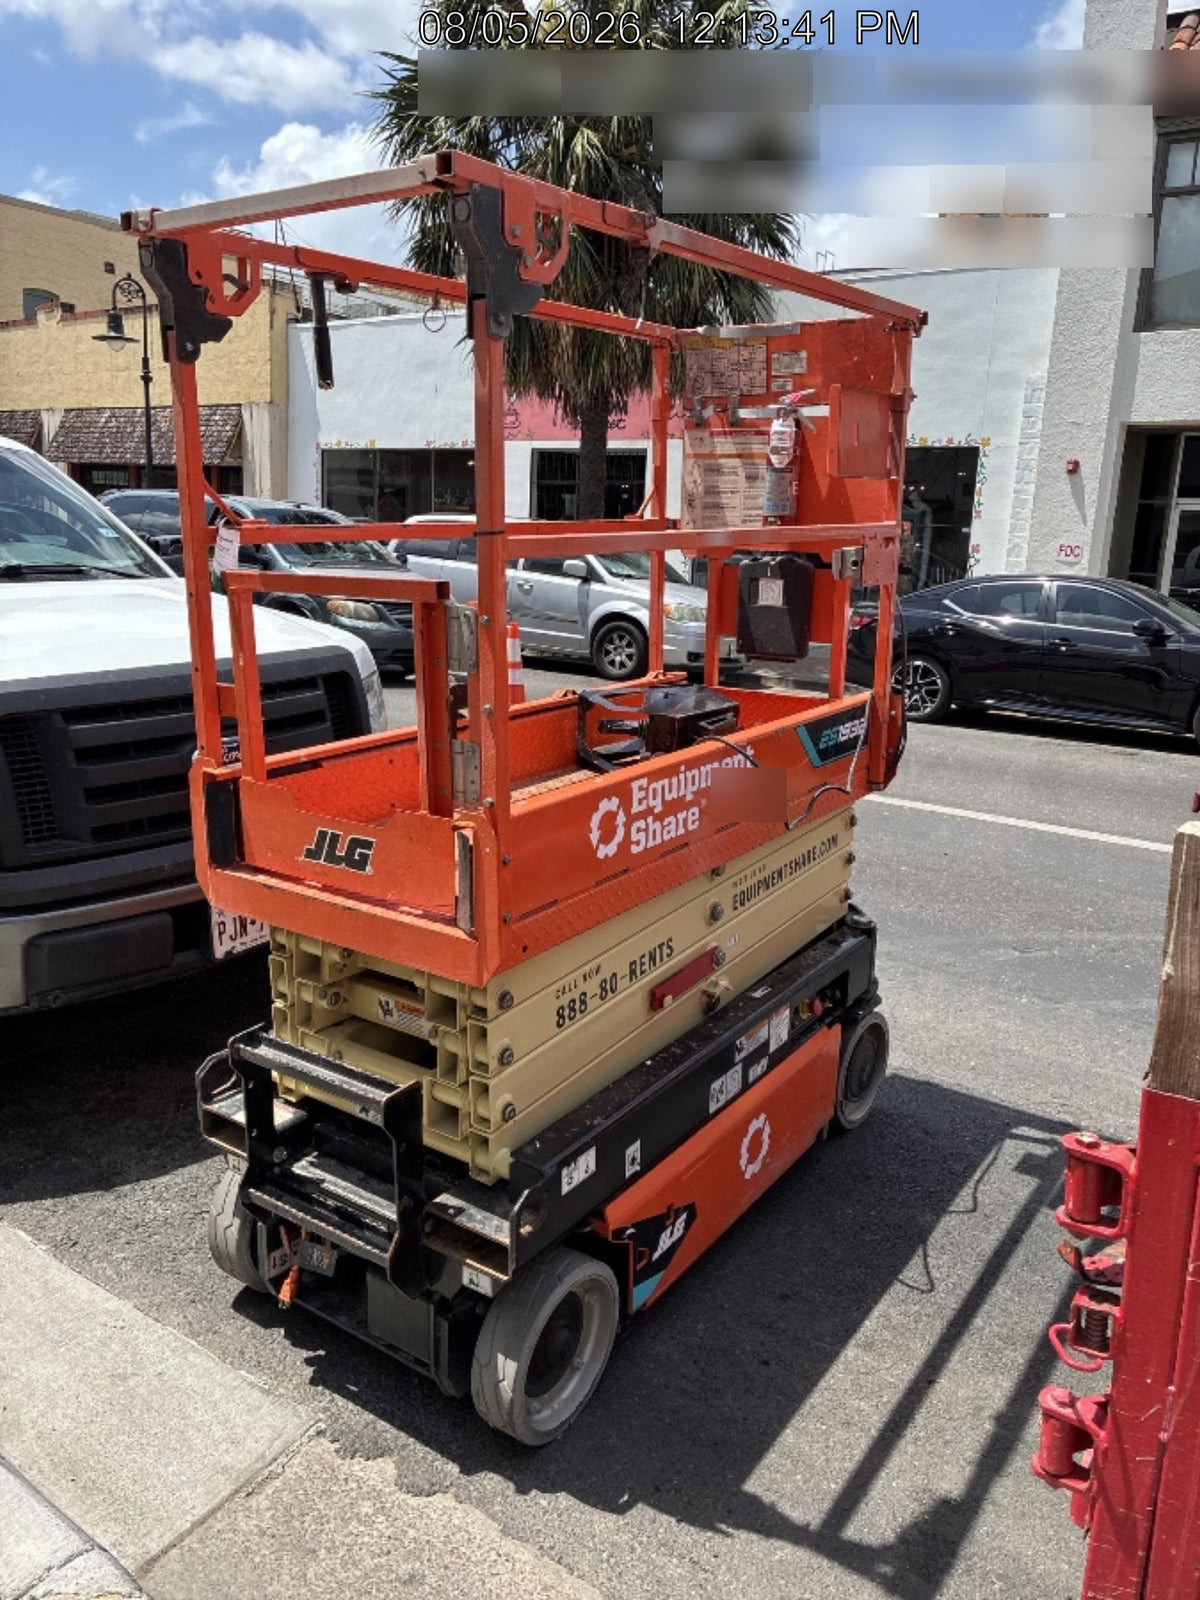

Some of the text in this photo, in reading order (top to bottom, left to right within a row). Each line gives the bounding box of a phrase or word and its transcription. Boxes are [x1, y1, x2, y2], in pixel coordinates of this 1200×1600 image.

[1058, 543, 1081, 558] FDC
[302, 826, 377, 875] JLG
[630, 807, 700, 855] Share
[732, 833, 838, 911] EQUIPMENTSHARE.COM
[555, 979, 578, 1000] CALL
[556, 936, 674, 1029] 888-80-RENTS
[651, 1210, 689, 1263] JLG
